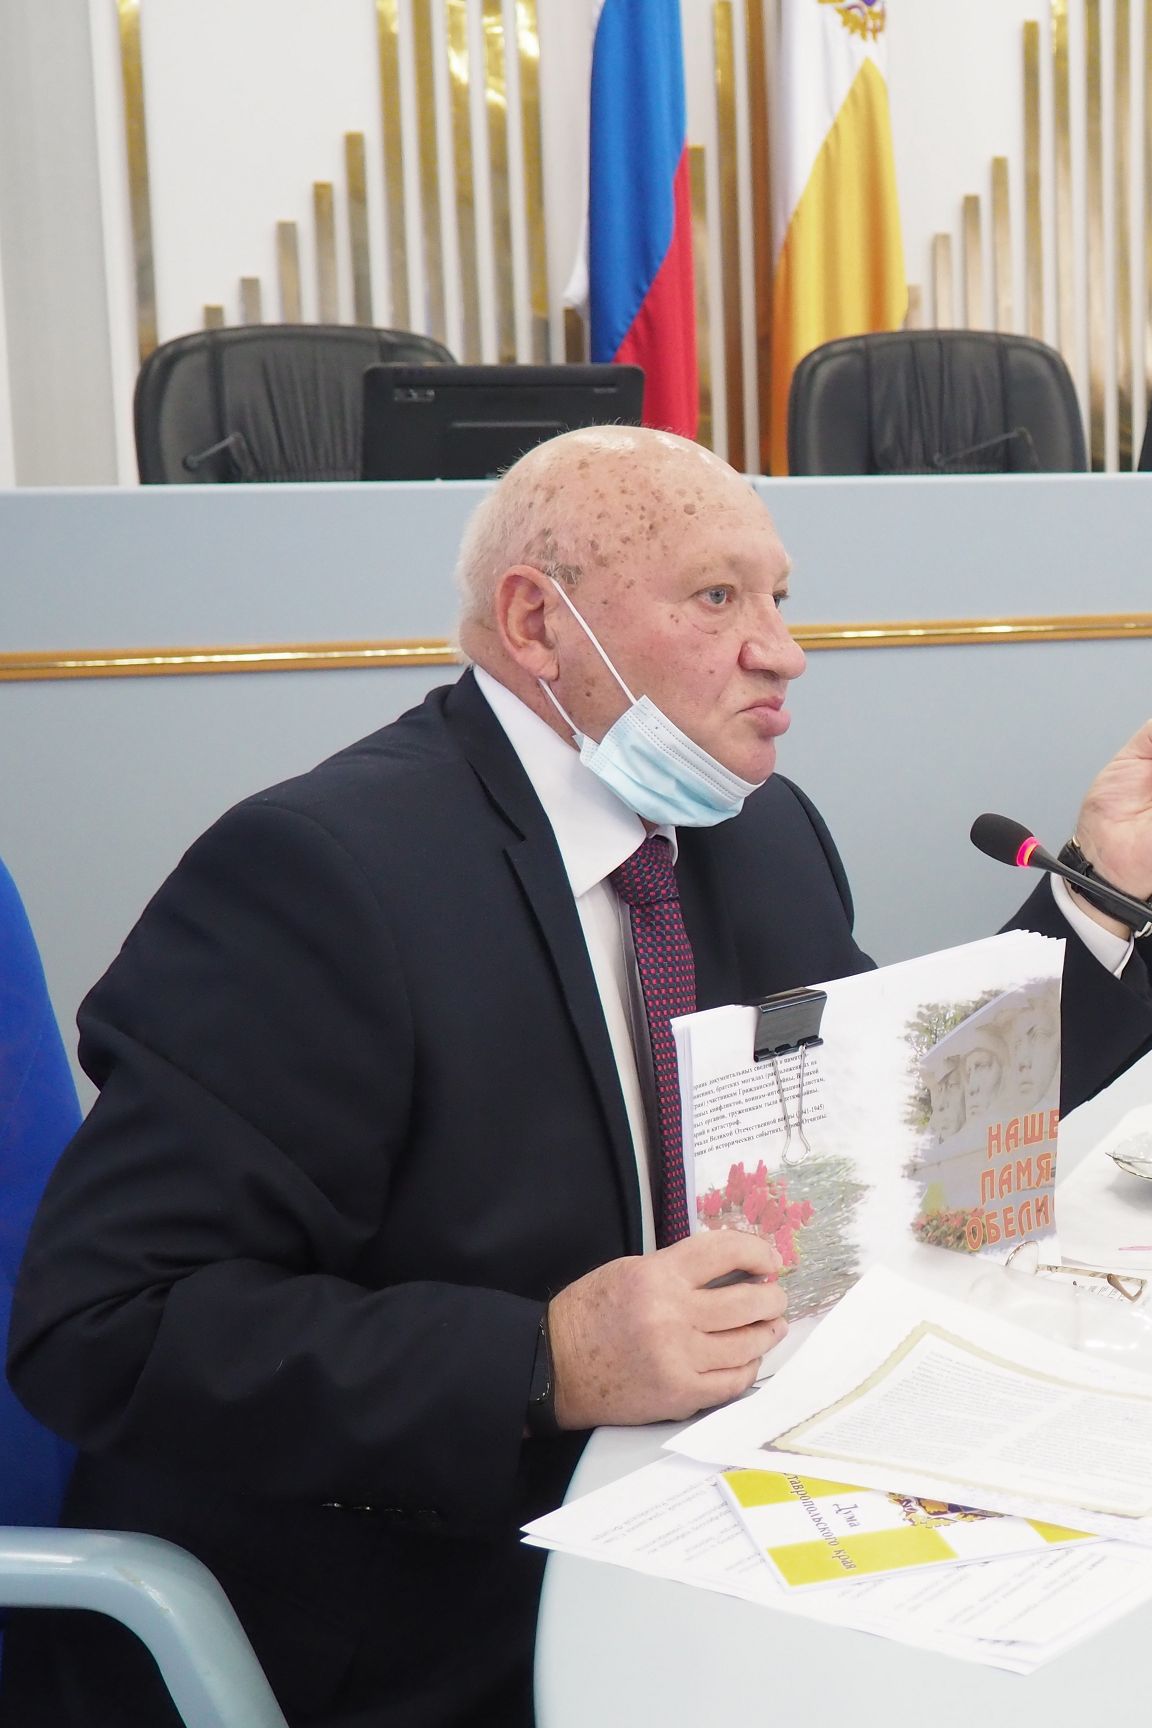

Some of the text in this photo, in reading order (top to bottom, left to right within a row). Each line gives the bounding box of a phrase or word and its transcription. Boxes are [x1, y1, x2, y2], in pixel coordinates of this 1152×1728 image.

[980, 1151, 1057, 1206] ПАМЯ
[965, 1194, 1056, 1251] ОБЕЛИ
[783, 1472, 857, 1570] тавропольского края
